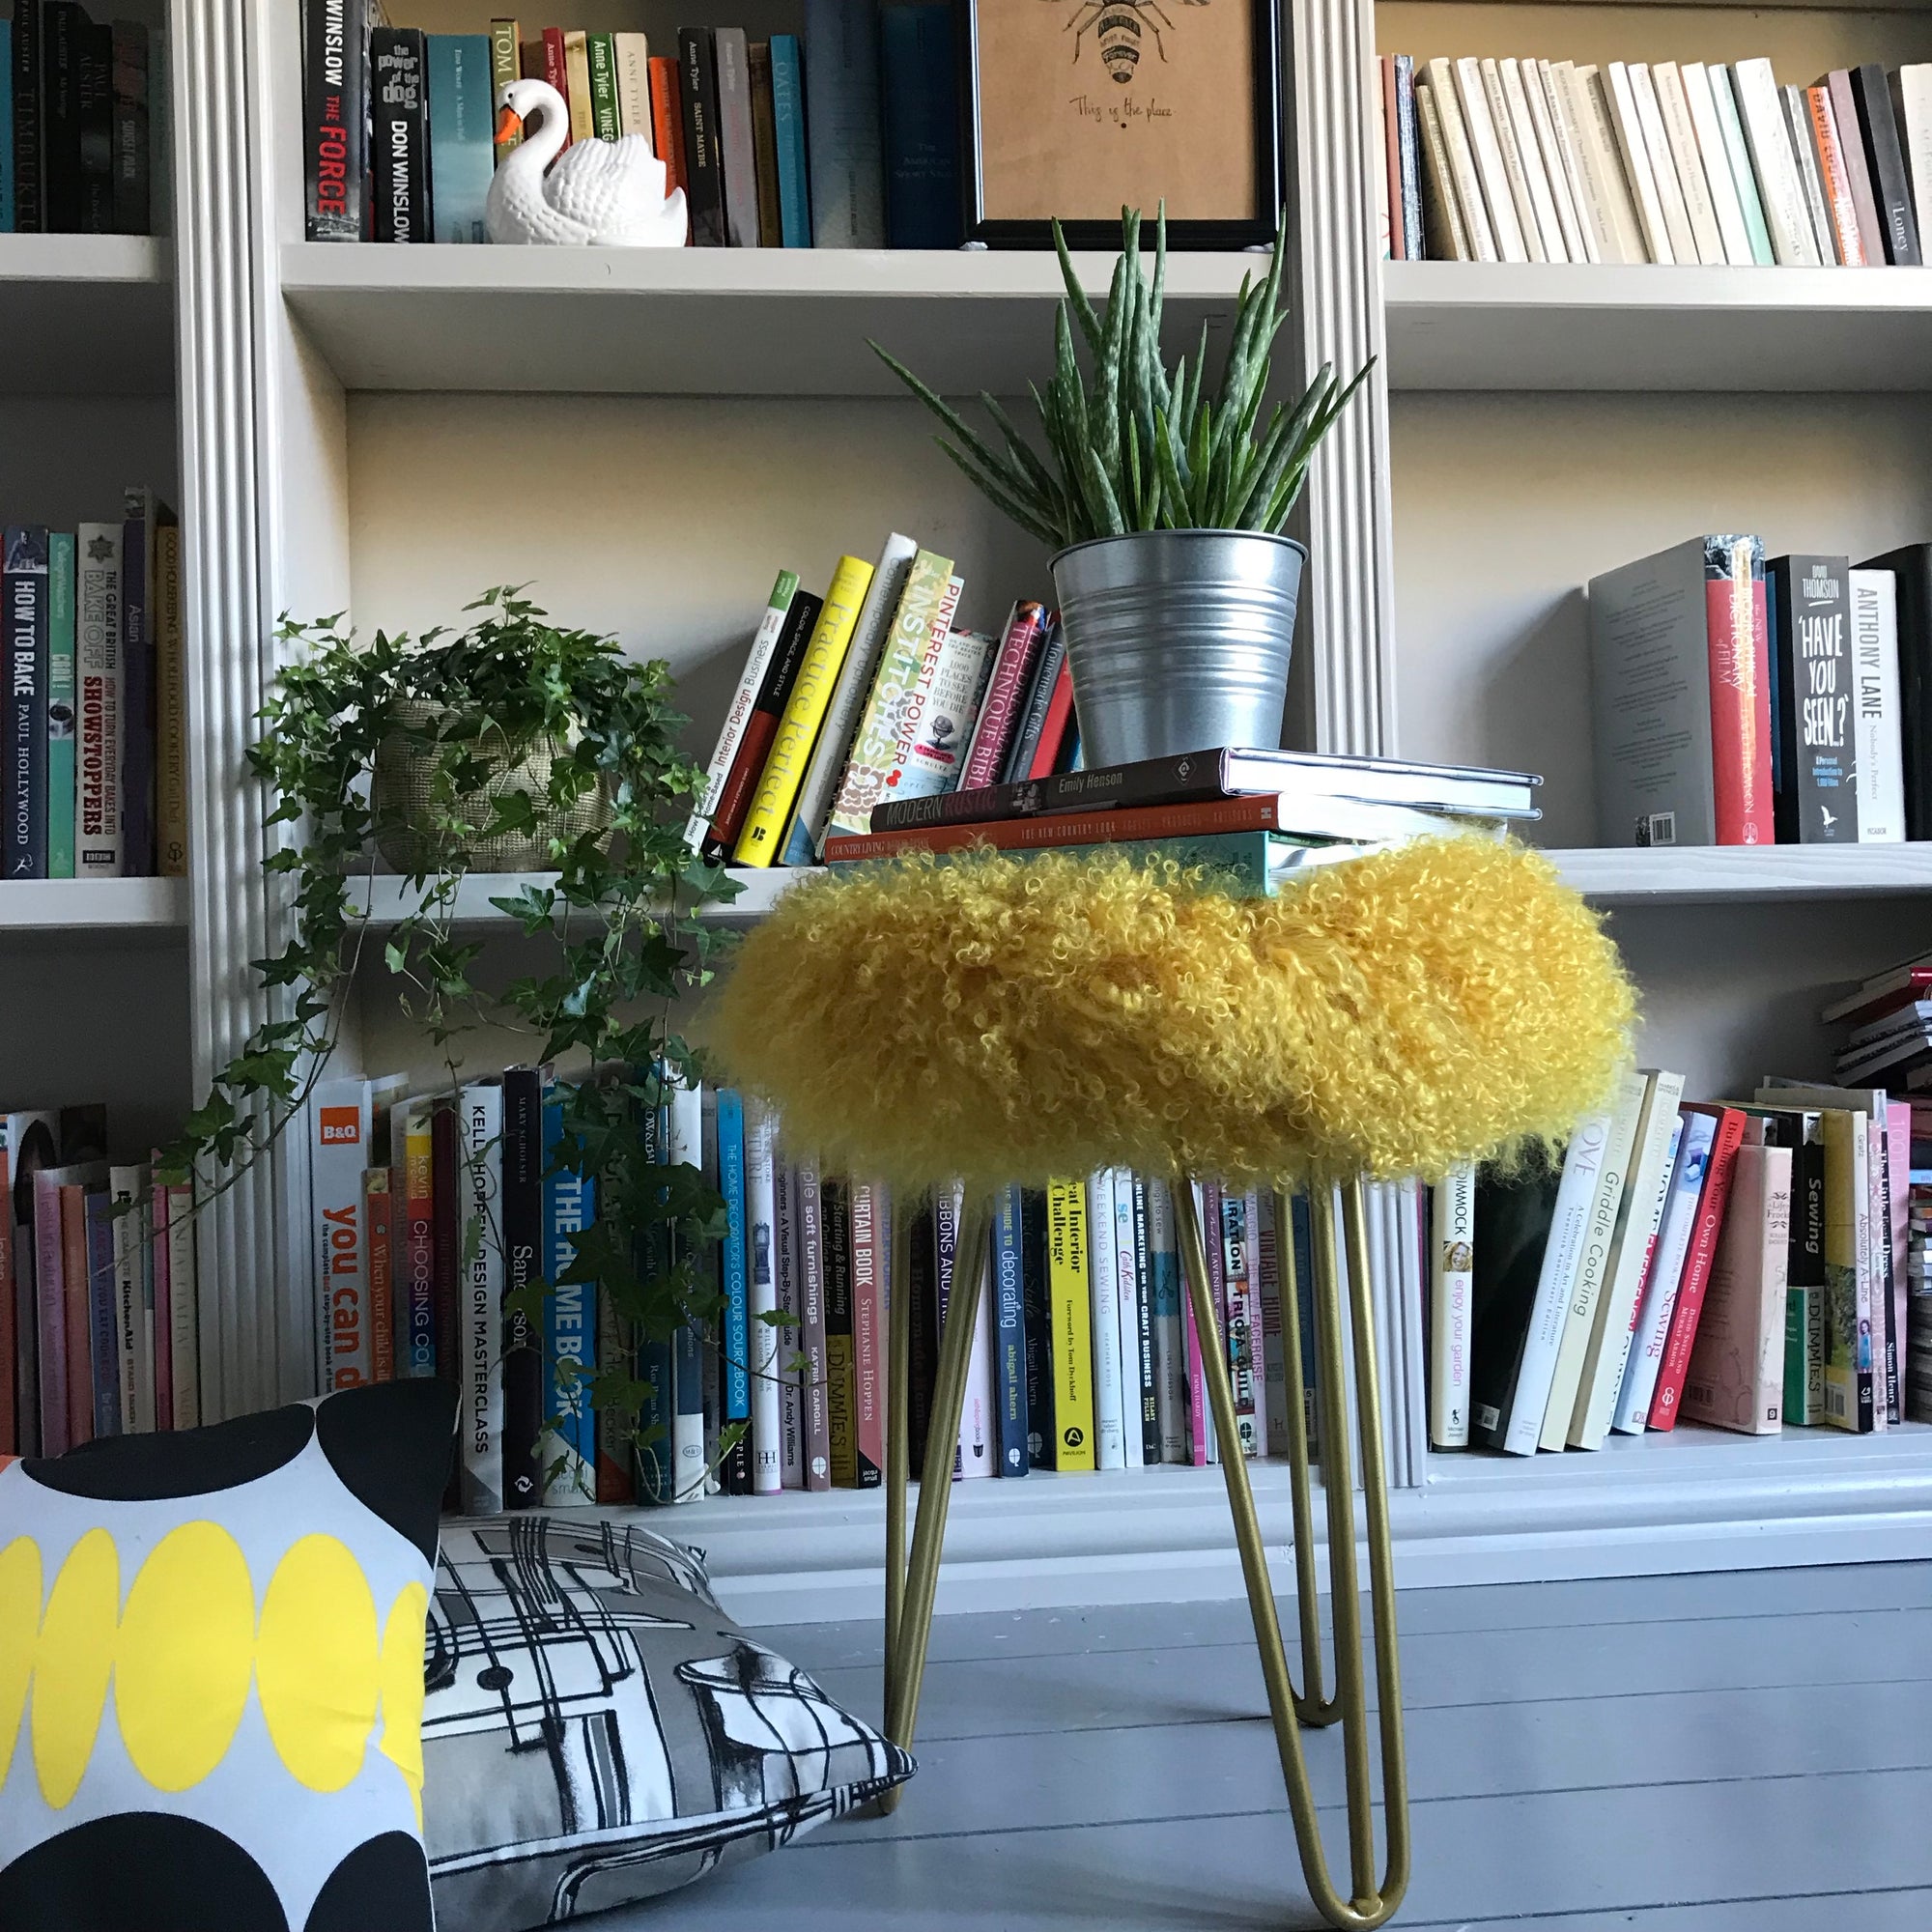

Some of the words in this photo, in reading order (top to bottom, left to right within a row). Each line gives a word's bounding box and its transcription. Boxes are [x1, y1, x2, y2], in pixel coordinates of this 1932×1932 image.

[21, 31, 31, 73] AUSTER
[326, 0, 344, 86] WINSLOW
[394, 44, 409, 55] the
[496, 26, 512, 74] TOM
[546, 43, 556, 67] Anne
[594, 42, 608, 69] Anne
[689, 42, 698, 65] Anne
[79, 54, 94, 109] AUSTER
[594, 71, 609, 99] Tyler
[628, 50, 638, 83] ANNE
[690, 67, 700, 91] Tyler
[326, 96, 340, 121] THE
[631, 88, 641, 127] TYLER
[774, 62, 792, 122] OATES
[1067, 95, 1102, 123] This
[1123, 97, 1143, 117] the
[694, 102, 703, 132] SAINT
[1813, 93, 1830, 139] DAVID
[122, 120, 135, 153] SUNSET
[391, 121, 408, 157] DON
[696, 134, 706, 167] MAYBE
[122, 155, 136, 178] PARK
[319, 126, 347, 214] FORCE
[391, 160, 410, 242] WINSLOW
[1891, 207, 1909, 251] Loney
[84, 570, 105, 622] BAKE
[105, 571, 117, 590] THE
[1803, 579, 1839, 599] THOMSON
[14, 581, 36, 622] HOW
[105, 593, 117, 631] GREAT
[14, 626, 36, 648] TO
[128, 605, 143, 642] Asian
[917, 583, 960, 689] PINTEREST
[1856, 587, 1881, 669] ANTHONY
[84, 625, 104, 669] OFF
[105, 633, 117, 669] BRITISH
[794, 600, 854, 713] Practice
[1728, 594, 1746, 696] DICTIONARY
[14, 651, 36, 696] BAKE
[104, 677, 116, 695] HOW
[773, 675, 786, 696] STYLE
[939, 676, 951, 688] TO
[952, 681, 968, 695] SEE
[980, 624, 1031, 742] TECHNIQUE
[1034, 640, 1064, 712] Homemade
[1719, 650, 1732, 684] FILM
[1808, 658, 1836, 696] YOU
[104, 696, 116, 709] TO
[714, 726, 738, 767] Interior
[728, 688, 752, 725] Design
[740, 639, 769, 686] Business
[932, 697, 948, 709] YOU
[949, 701, 965, 714] DIE
[934, 686, 967, 704] BEFORE
[1861, 675, 1883, 720] LANE
[17, 703, 30, 743] PAUL
[104, 712, 116, 735] TURN
[892, 692, 925, 766] POWER
[1023, 711, 1044, 741] Gifts
[83, 676, 103, 836] SHOWSTOPPERS
[104, 738, 116, 784] EVERYDAY
[754, 717, 811, 816] Perfect
[16, 747, 30, 845] HOLLYWOOD
[104, 787, 116, 814] BAKES
[1059, 776, 1085, 794] Emily
[1086, 772, 1123, 789] Henson
[1742, 750, 1754, 813] THOMSON
[104, 816, 116, 835] INTO
[886, 795, 945, 826] MODERN
[944, 787, 997, 816] RUSTIC
[688, 819, 699, 838] How
[831, 842, 862, 856] COUNTRY
[861, 840, 886, 854] LIVING
[518, 1096, 527, 1126] MARY
[323, 1125, 356, 1139] B&Q
[1715, 1121, 1739, 1176] Building
[1857, 1134, 1866, 1158] Gratz
[726, 1144, 737, 1161] THE
[417, 1154, 430, 1199] kevin
[726, 1163, 738, 1195] HOME
[1709, 1179, 1726, 1210] Your
[554, 1178, 582, 1233] THE
[805, 1205, 818, 1236] soft
[1593, 1171, 1620, 1237] Griddle
[1806, 1178, 1822, 1254] Sewing
[323, 1206, 358, 1275] you
[727, 1198, 741, 1269] DECORATOR'S
[781, 1228, 791, 1256] Visual
[833, 1203, 846, 1252] Starting
[1004, 1234, 1013, 1246] TO
[1050, 1185, 1065, 1265] Challenge
[1069, 1210, 1083, 1274] Interior
[1136, 1213, 1146, 1269] MARKETING
[1566, 1213, 1584, 1261] Celebration
[1699, 1214, 1717, 1249] Own
[1857, 1213, 1869, 1264] Absolutely
[373, 1243, 386, 1276] When
[412, 1220, 430, 1327] CHOOSING
[836, 1254, 845, 1264] &
[855, 1247, 873, 1287] BOOK
[1119, 1250, 1134, 1270] Cath
[1260, 1230, 1279, 1288] VINTAGE
[1689, 1251, 1708, 1293] Home
[372, 1277, 387, 1310] your
[474, 1248, 488, 1319] DESIGN
[730, 1271, 743, 1322] COLOUR
[805, 1239, 820, 1325] furnishings
[835, 1265, 848, 1315] Running
[1000, 1250, 1022, 1328] decorating
[1098, 1257, 1111, 1315] SEWING
[1122, 1269, 1134, 1301] Kidston
[1210, 1252, 1221, 1305] LAVENDER
[1452, 1279, 1465, 1312] enjoy
[1558, 1289, 1568, 1304] and
[1562, 1272, 1572, 1288] Art
[1575, 1243, 1605, 1317] Cooking
[1860, 1266, 1870, 1303] A-Line
[122, 1280, 135, 1351] KitchenAid
[332, 1288, 360, 1360] can
[860, 1297, 873, 1366] STEPHANIE
[1065, 1299, 1074, 1336] Foreword
[1141, 1306, 1150, 1336] CRAFT
[1452, 1315, 1464, 1343] your
[1548, 1305, 1567, 1348] Literature
[1646, 1290, 1677, 1359] Sewing
[1676, 1306, 1690, 1338] MURRAY
[1687, 1308, 1697, 1332] DAVID
[375, 1321, 390, 1354] child
[1026, 1337, 1038, 1373] Abigail
[1065, 1337, 1074, 1347] by
[1251, 1314, 1264, 1381] FACERCISE
[1668, 1339, 1679, 1368] ARMOR
[1682, 1333, 1691, 1356] SNELL
[1807, 1304, 1823, 1392] DUMMIES
[1886, 1341, 1896, 1372] Simon
[731, 1324, 746, 1407] SOURCEBOOK
[1006, 1344, 1018, 1384] abigail
[1142, 1340, 1151, 1387] BUSINESS
[1452, 1344, 1466, 1387] garden
[1675, 1360, 1685, 1375] AND
[474, 1321, 489, 1454] MASTERCLASS
[785, 1385, 794, 1399] Dr.
[827, 1351, 848, 1447] DUMMIES
[863, 1369, 875, 1422] HOPPEN
[1008, 1386, 1018, 1420] ahern
[1067, 1366, 1077, 1402] Dyckhoff
[1887, 1374, 1896, 1405] Henry
[783, 1401, 794, 1426] Andy
[812, 1389, 822, 1435] CARGILL
[1193, 1395, 1202, 1418] HARDY
[786, 1427, 795, 1466] Williams
